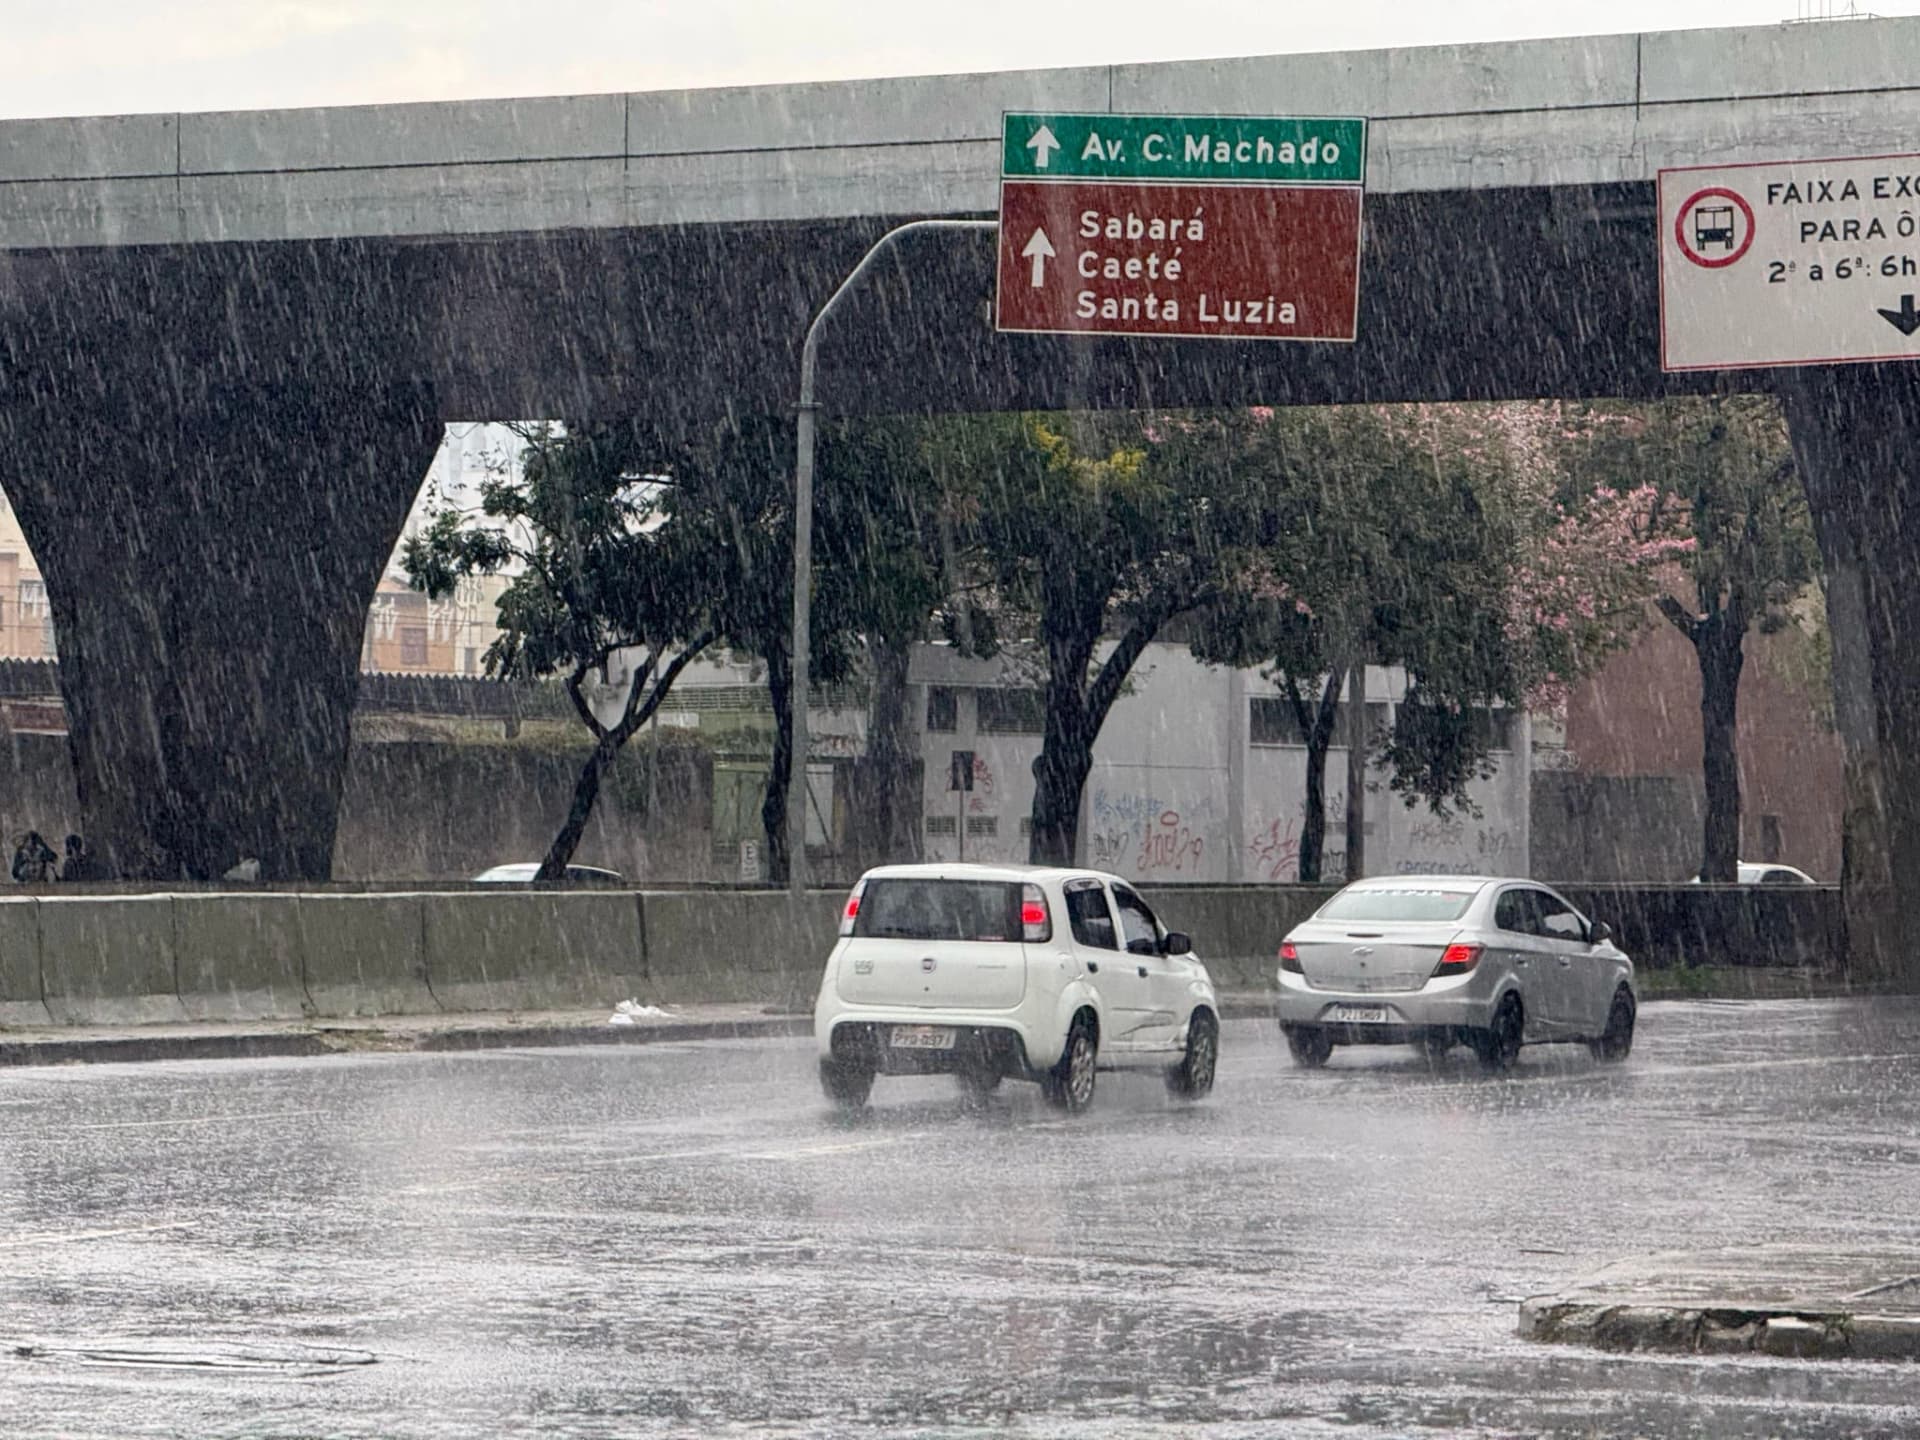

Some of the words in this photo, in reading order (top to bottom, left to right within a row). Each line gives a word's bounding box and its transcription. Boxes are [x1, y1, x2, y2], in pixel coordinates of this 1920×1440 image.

[1081, 132, 1126, 162] Av.
[1142, 134, 1172, 161] C.
[1184, 135, 1340, 164] Machado
[1767, 180, 1860, 205] FAIXA
[1873, 175, 1920, 199] EX
[1079, 207, 1205, 241] Sabará
[1800, 217, 1887, 243] PARA
[1896, 210, 1920, 238] Ô
[1077, 247, 1182, 281] Caeté
[1809, 264, 1823, 281] a
[1880, 255, 1917, 277] 6h
[1076, 291, 1180, 322] Santa
[1198, 293, 1297, 324] Luzia
